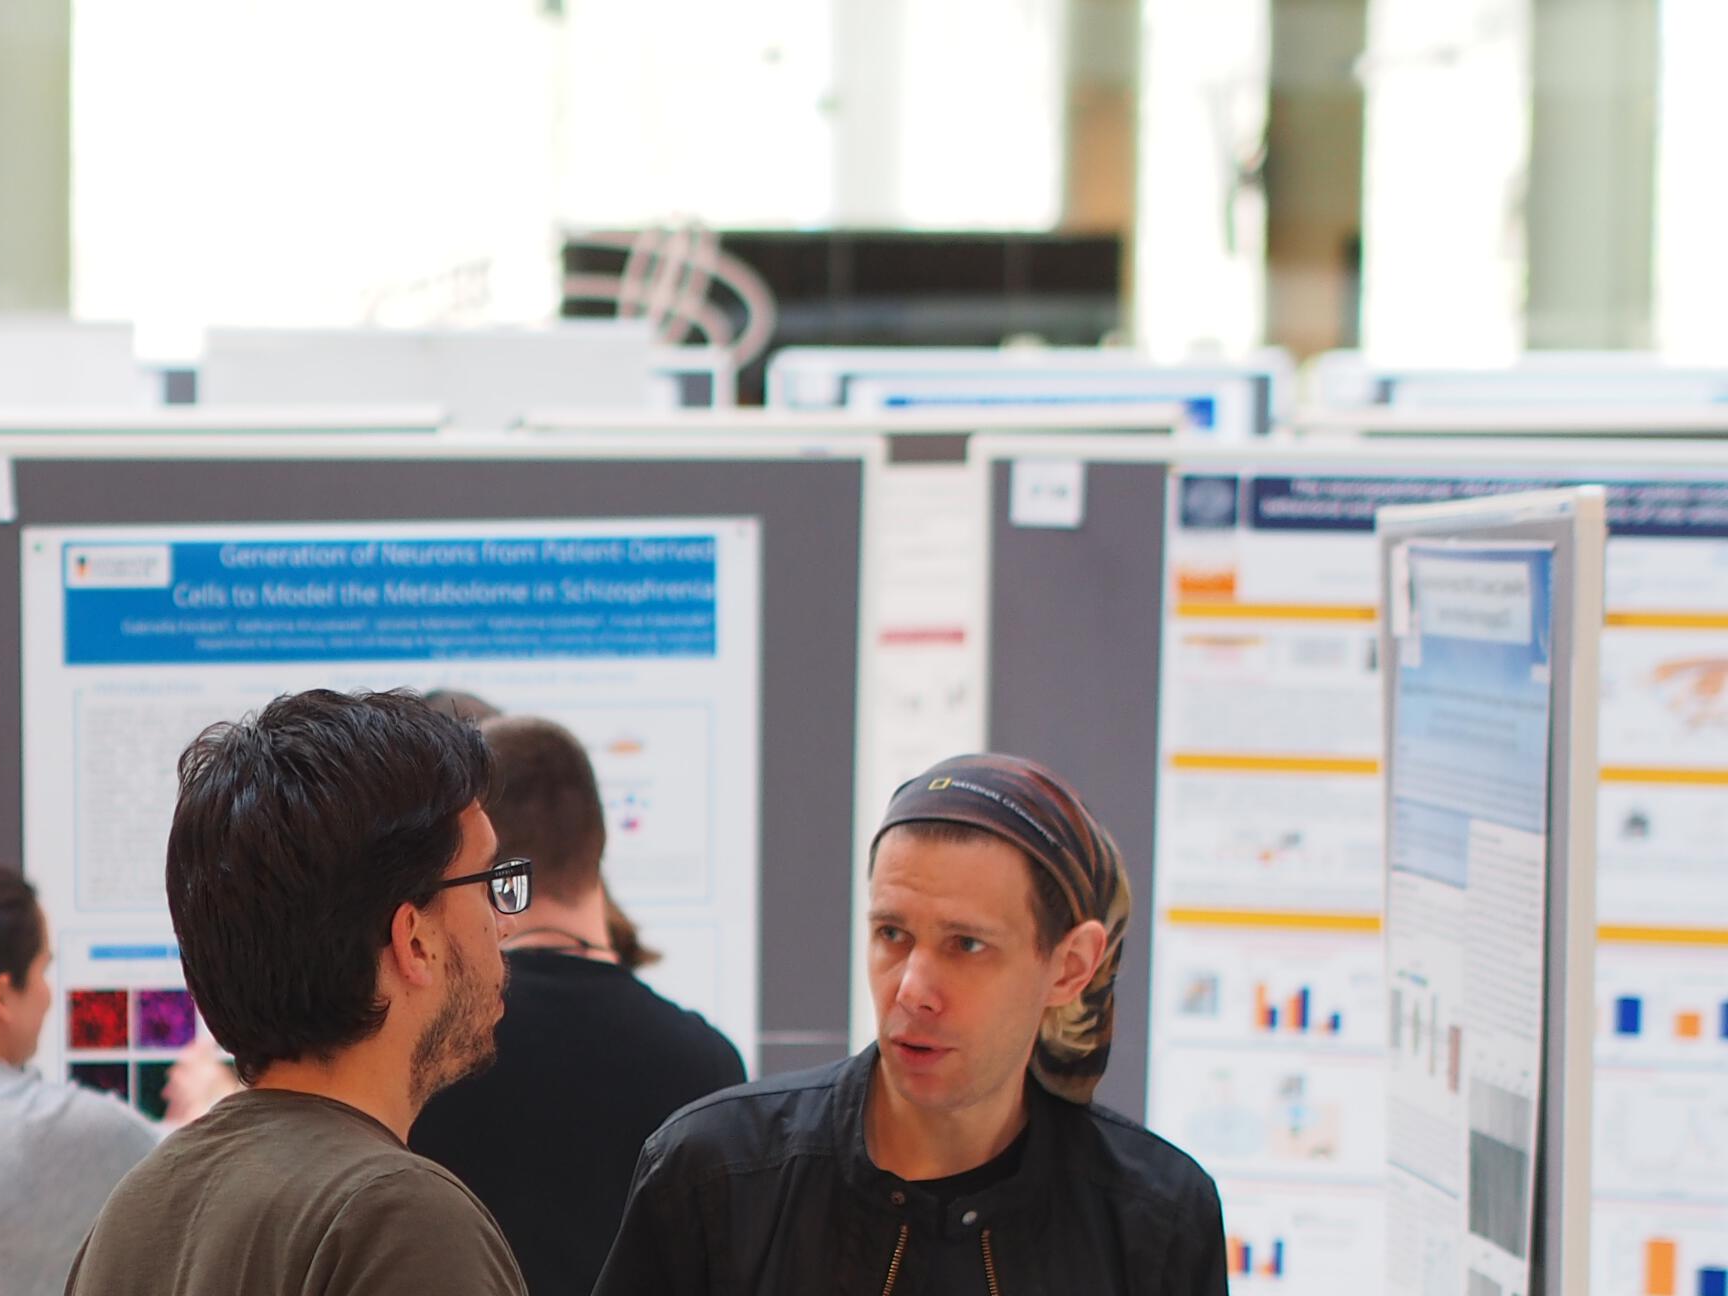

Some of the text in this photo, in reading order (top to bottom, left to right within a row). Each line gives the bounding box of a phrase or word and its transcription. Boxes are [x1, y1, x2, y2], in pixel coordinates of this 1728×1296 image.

[220, 544, 347, 567] Generation
[351, 543, 376, 566] of
[381, 542, 477, 566] Neurons
[482, 540, 536, 562] from
[173, 576, 715, 607] Cells to Model the Metabolome in Schizophrenia
[951, 780, 1002, 802] NATIONAL
